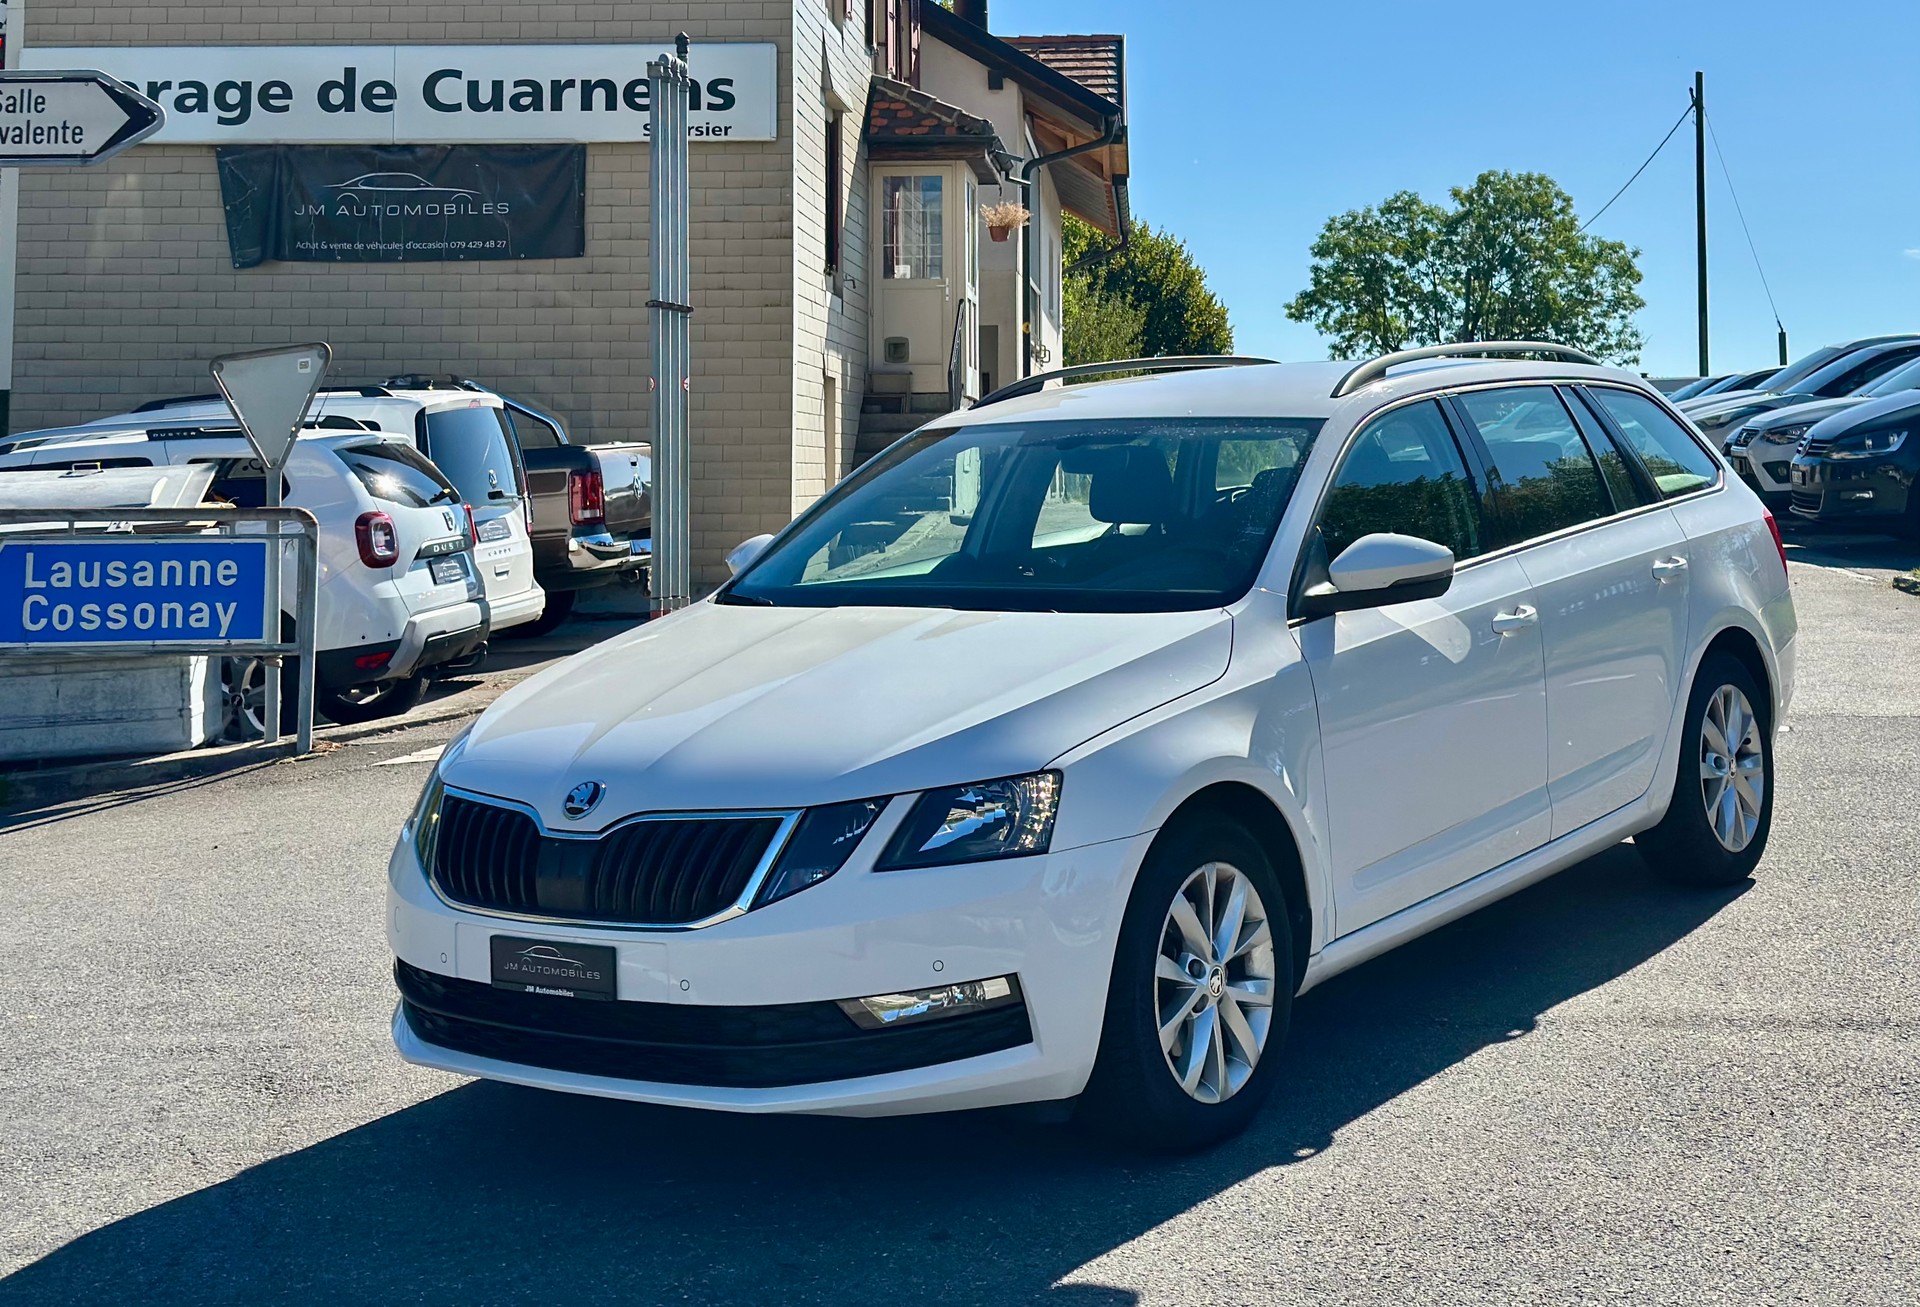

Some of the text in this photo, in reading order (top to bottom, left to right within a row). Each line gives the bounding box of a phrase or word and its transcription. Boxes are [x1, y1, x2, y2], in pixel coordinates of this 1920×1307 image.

[121, 78, 293, 126] rage
[316, 67, 397, 114] de
[294, 202, 510, 216] JM AUTOMOBILES
[295, 241, 319, 250] Achat
[320, 241, 328, 250] &
[329, 242, 352, 250] vente
[353, 241, 364, 250] de
[366, 241, 404, 250] véhicules
[449, 241, 466, 249] 079
[467, 240, 483, 249] 429
[484, 240, 495, 249] 48
[496, 240, 507, 248] 27
[24, 552, 238, 588] Lausanne
[22, 594, 237, 637] Cossonay
[504, 963, 600, 979] JM AUTOMOBILES
[525, 985, 574, 998] JM Automobiles
